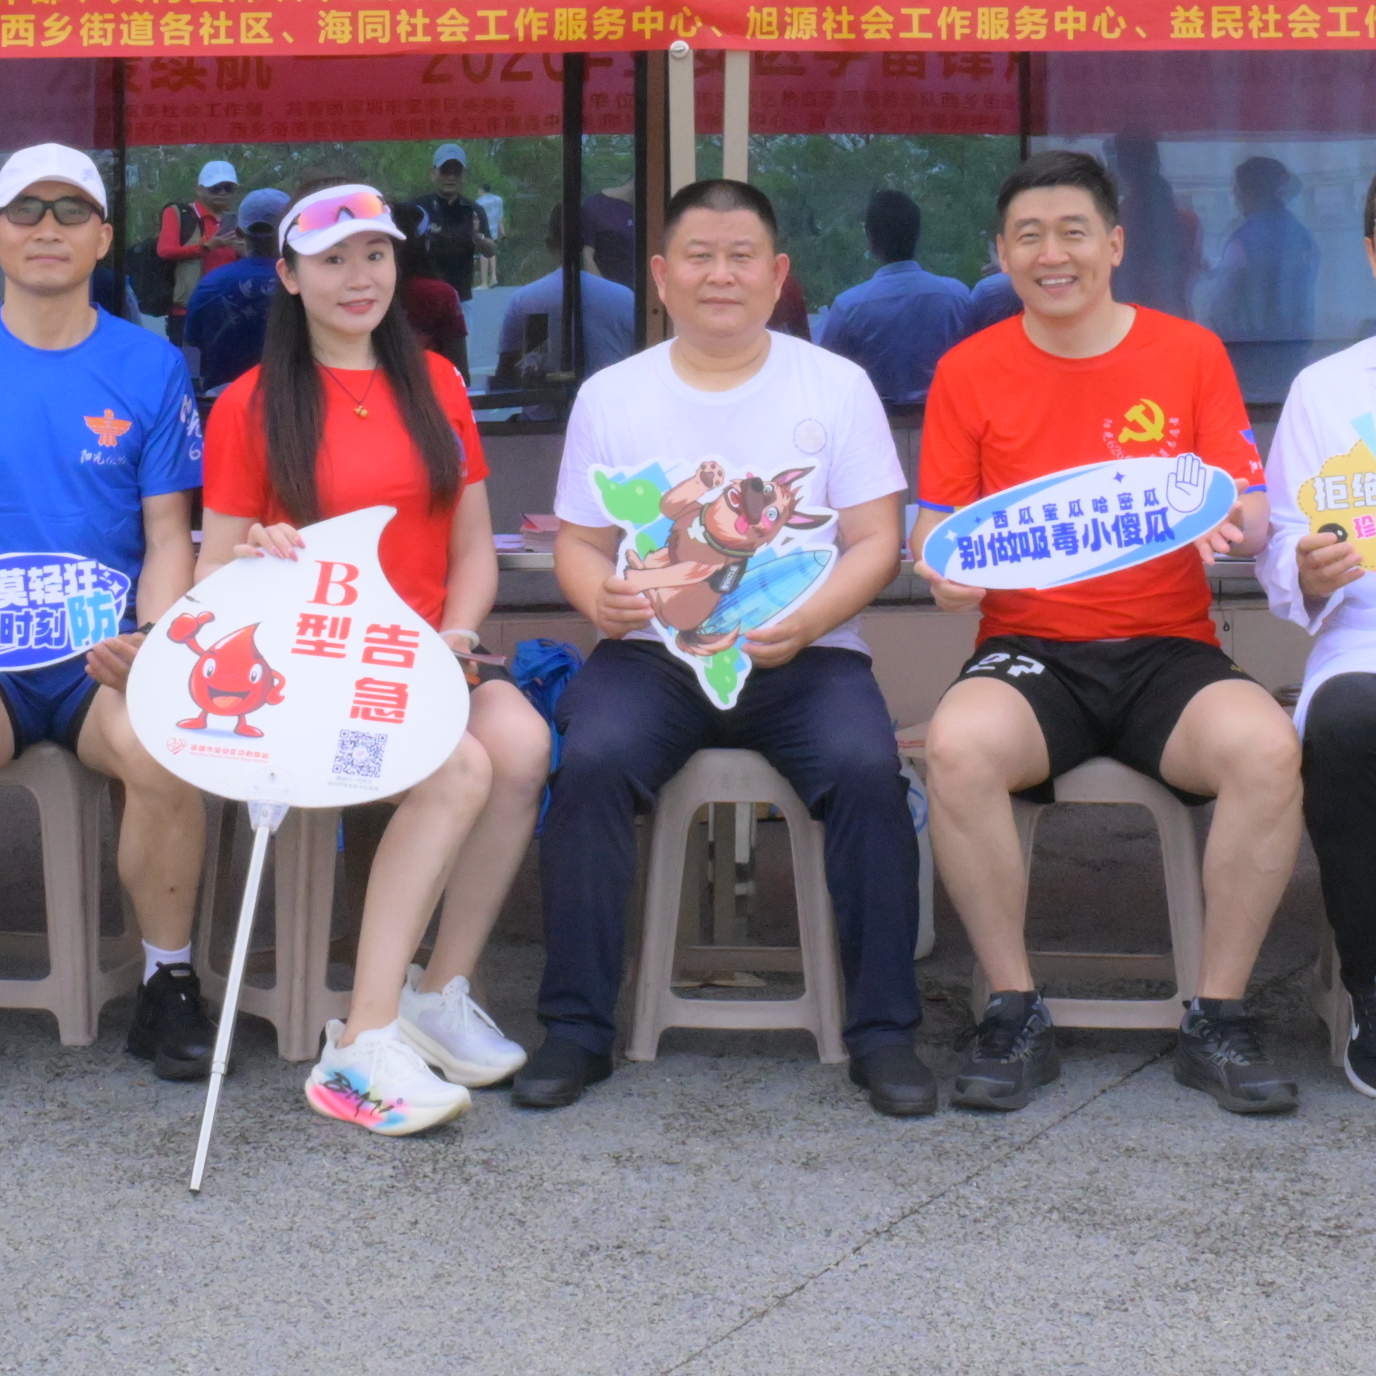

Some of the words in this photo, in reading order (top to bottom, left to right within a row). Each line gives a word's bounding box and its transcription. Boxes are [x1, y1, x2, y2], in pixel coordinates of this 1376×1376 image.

[956, 506, 1176, 571] 别做吸毒小傻瓜
[992, 487, 1160, 529] 西瓜蜜瓜哈密瓜
[348, 623, 421, 725] 告急
